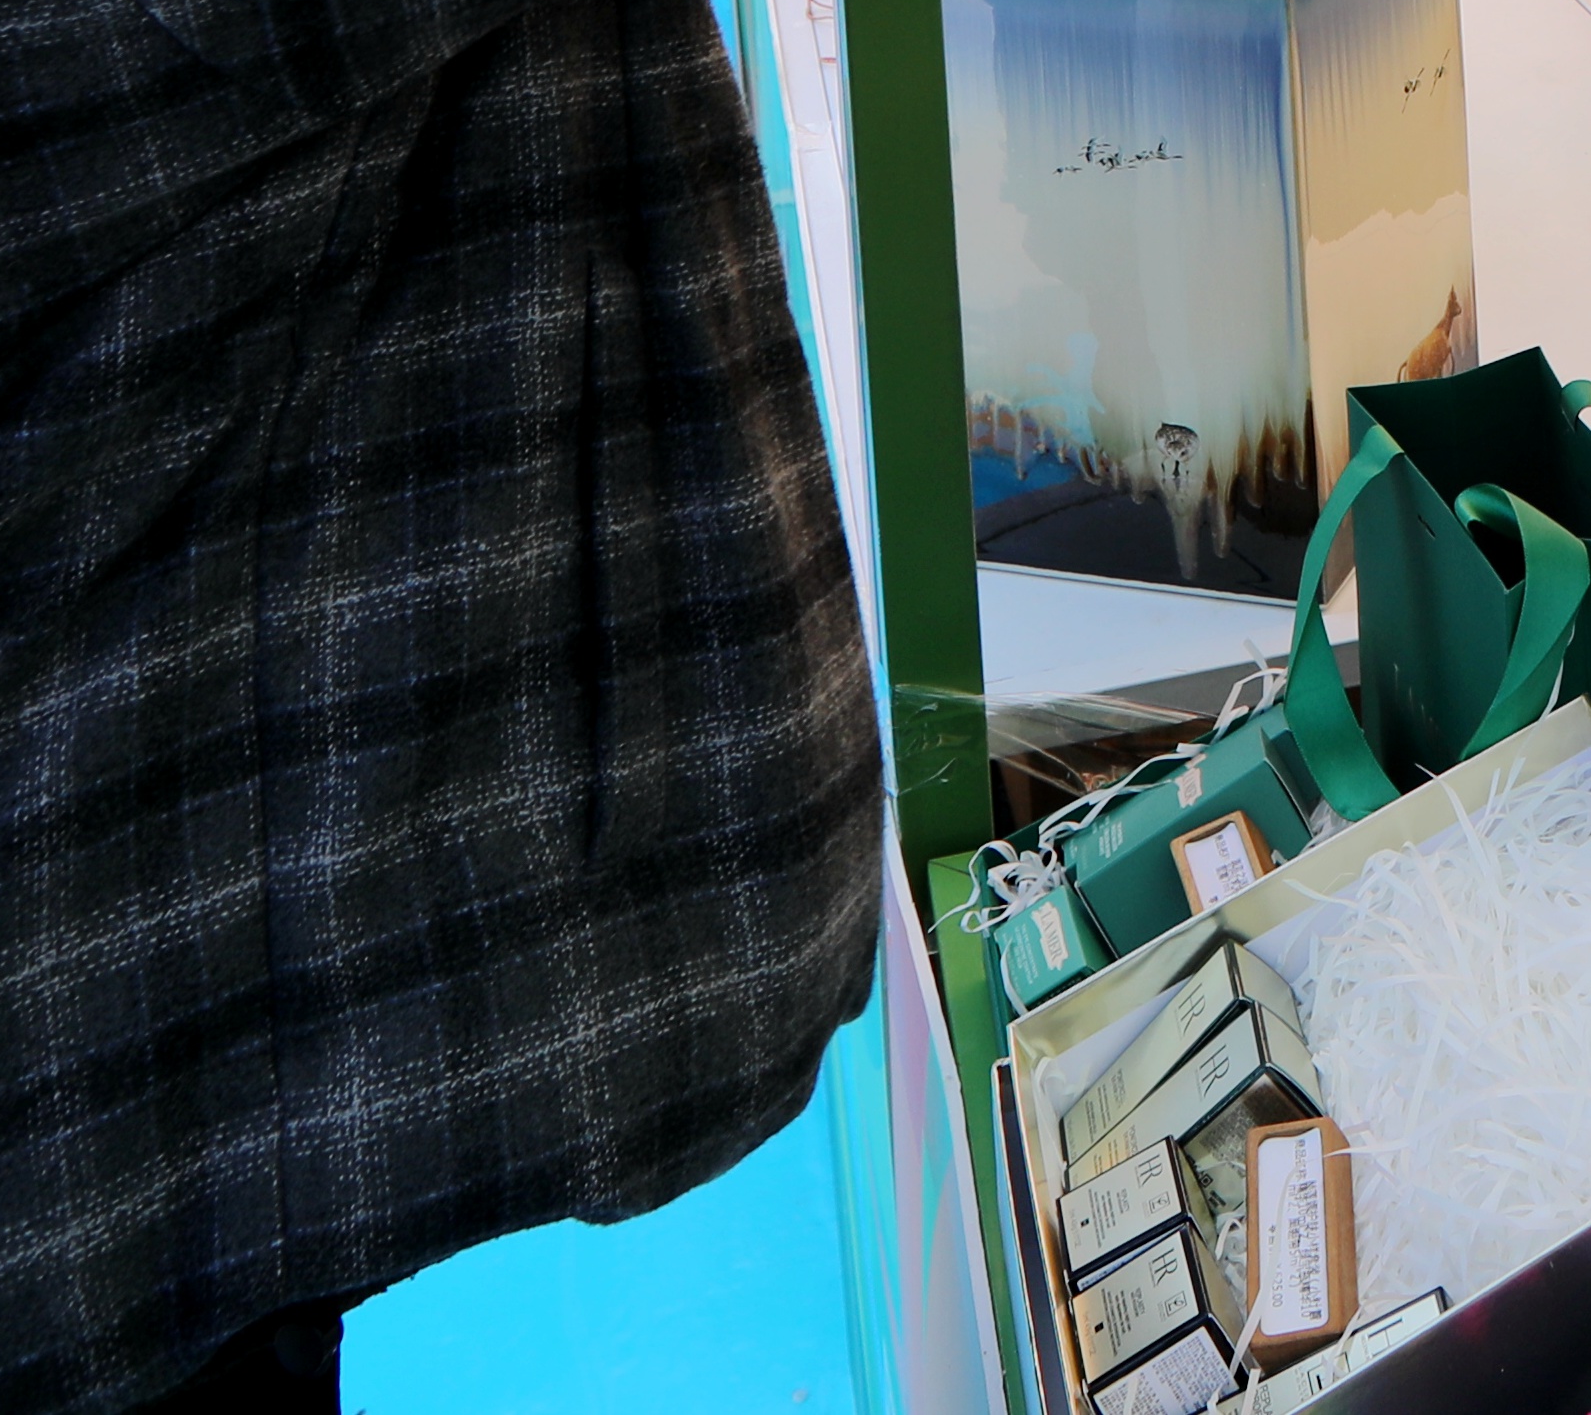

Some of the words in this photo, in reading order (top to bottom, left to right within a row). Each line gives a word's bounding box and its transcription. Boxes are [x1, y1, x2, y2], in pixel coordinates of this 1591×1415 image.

[1199, 1043, 1231, 1099] HR
[1137, 1154, 1163, 1187] HR
[1151, 1248, 1179, 1286] HR
